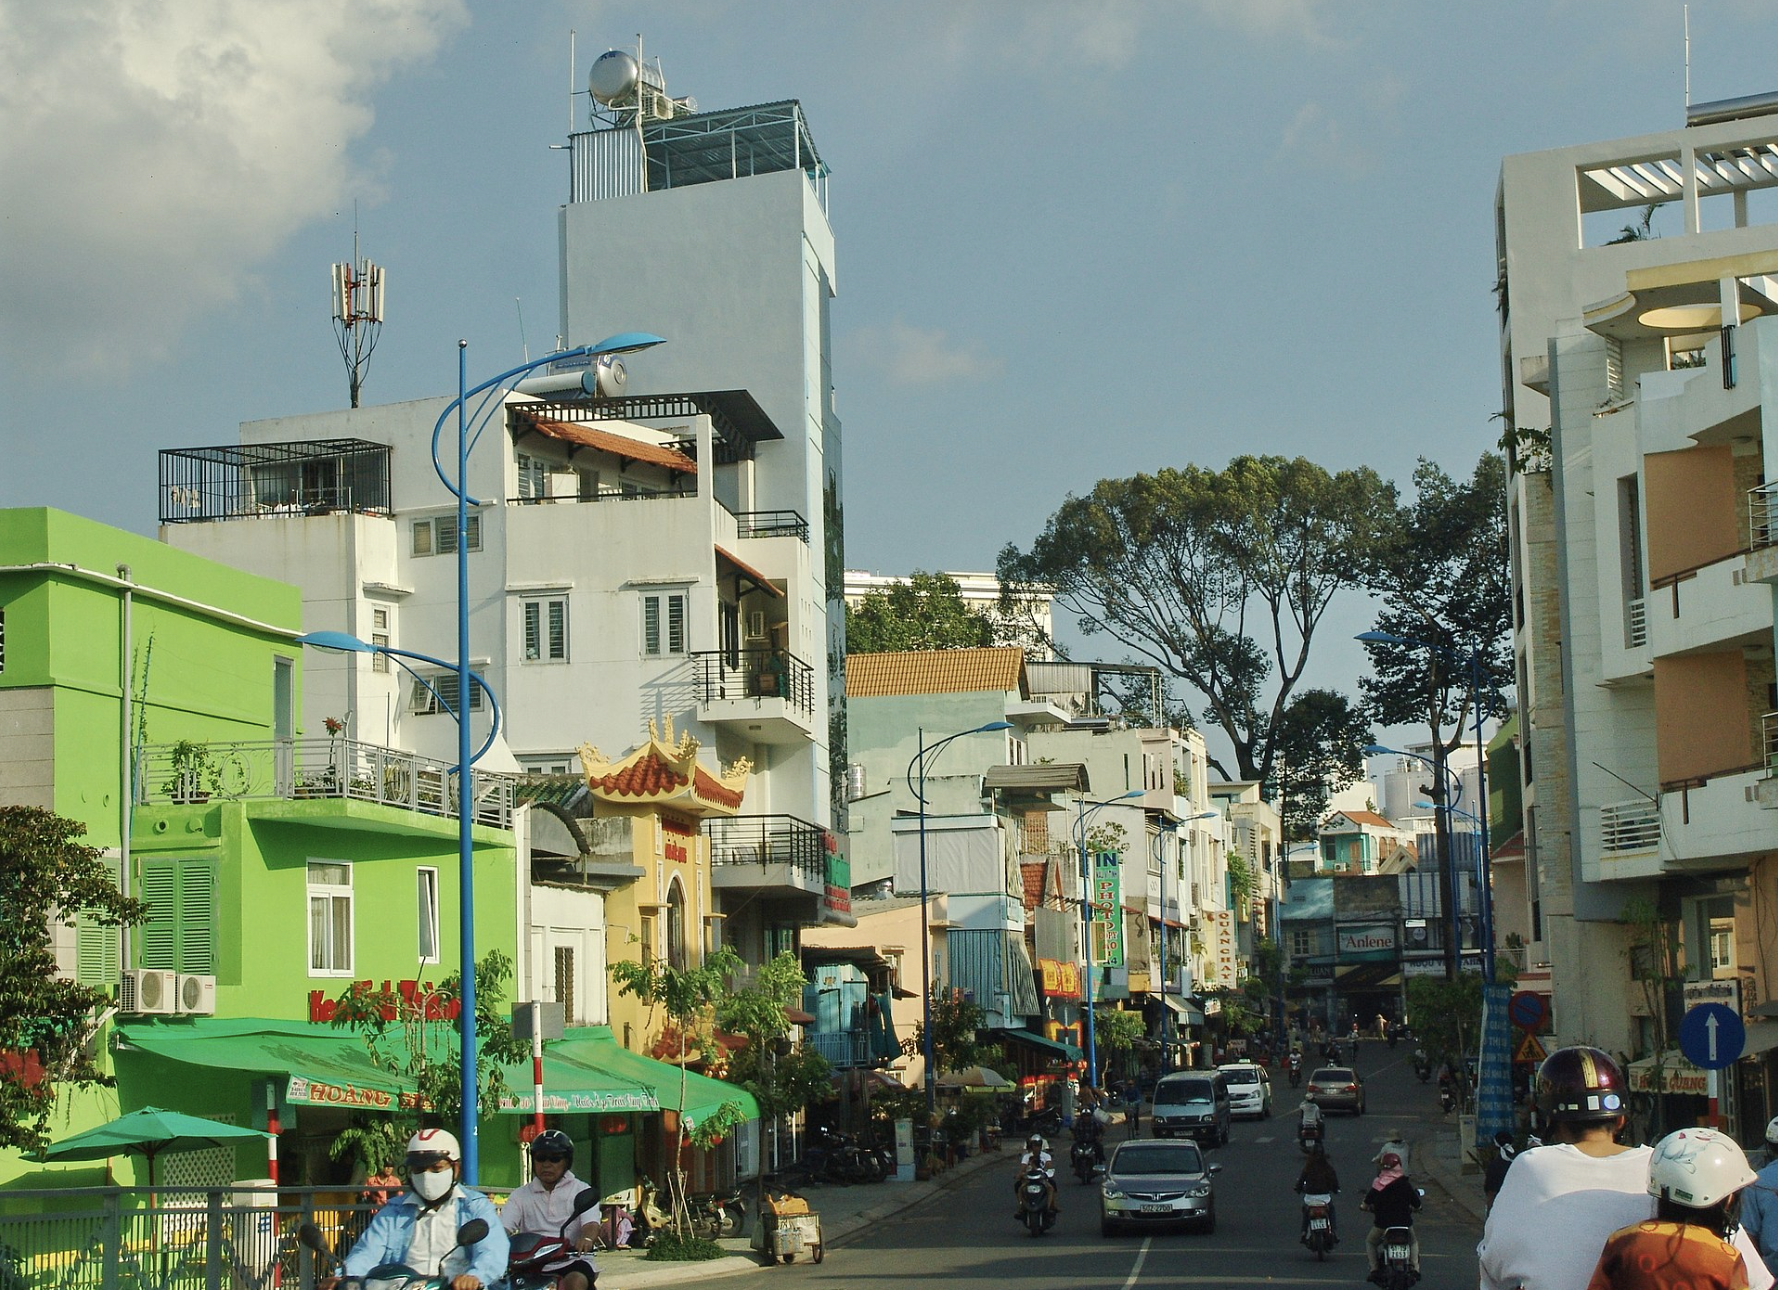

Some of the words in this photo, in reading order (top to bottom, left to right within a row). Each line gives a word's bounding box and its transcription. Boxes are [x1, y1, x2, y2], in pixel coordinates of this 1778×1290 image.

[1096, 853, 1117, 867] IN
[1099, 881, 1115, 930] PHOTO
[1346, 935, 1392, 948] Anlene
[1669, 1076, 1706, 1090] QUANG
[310, 1083, 391, 1107] HOÀNG
